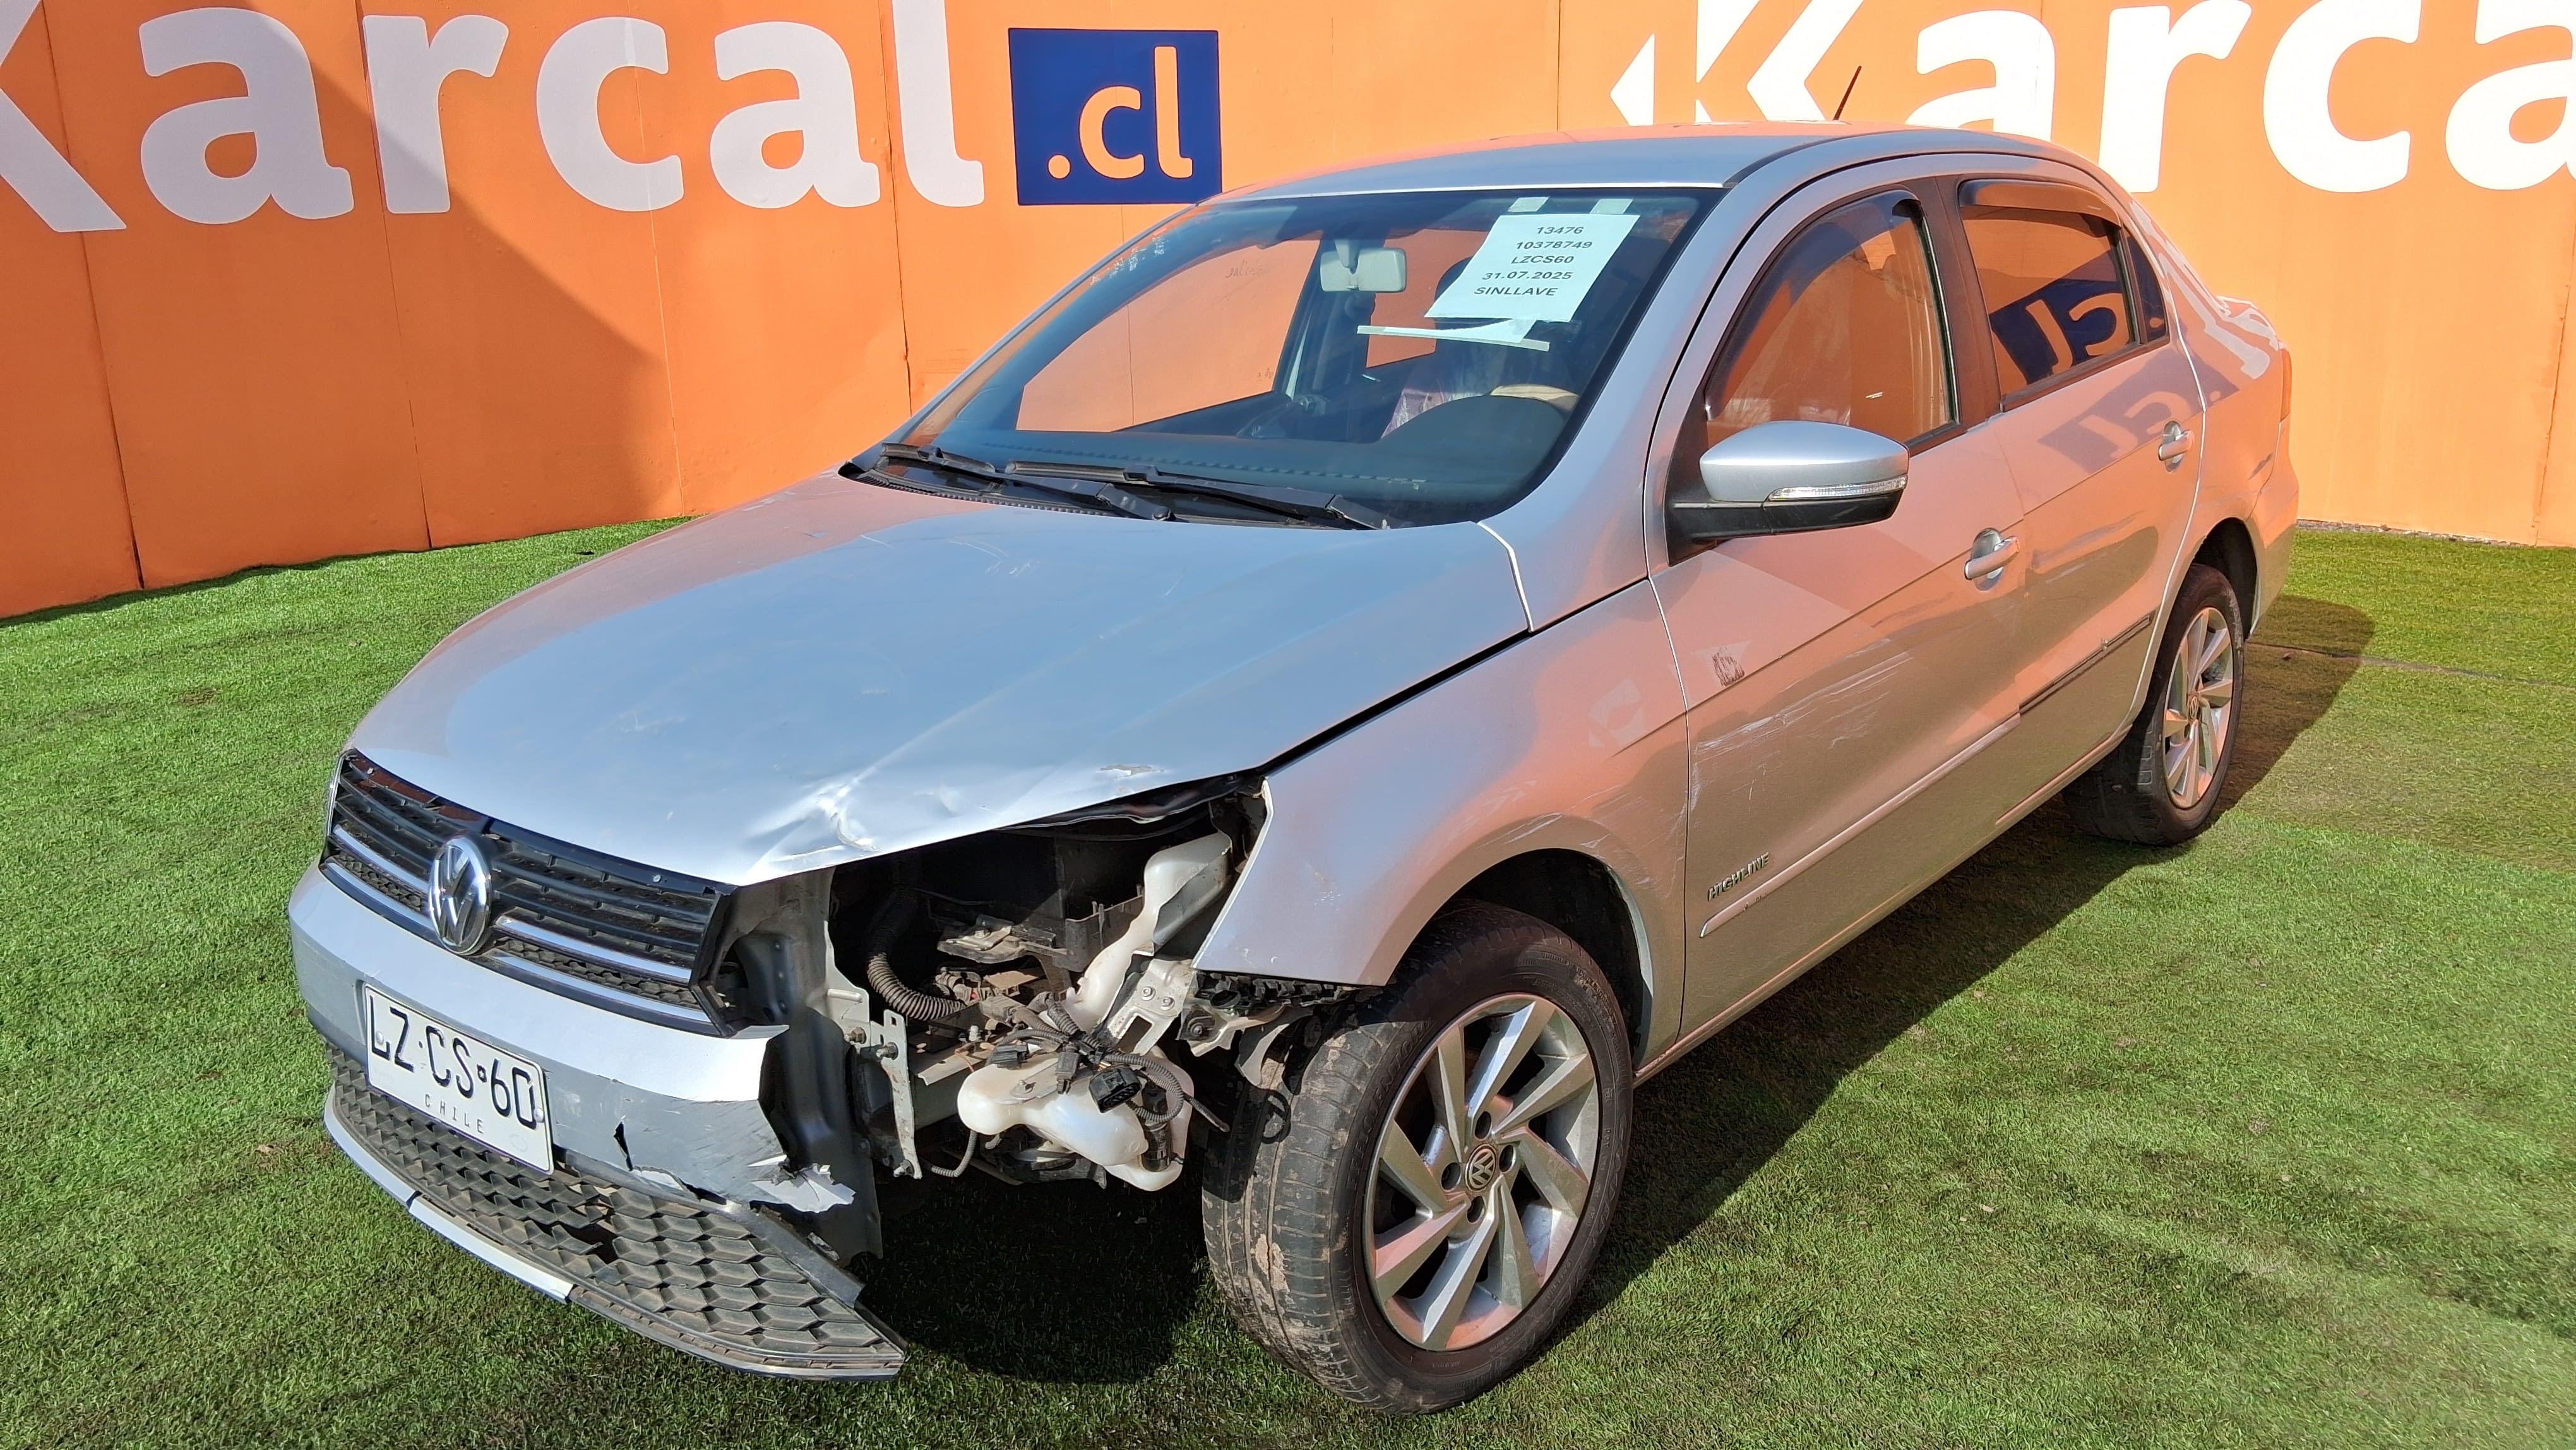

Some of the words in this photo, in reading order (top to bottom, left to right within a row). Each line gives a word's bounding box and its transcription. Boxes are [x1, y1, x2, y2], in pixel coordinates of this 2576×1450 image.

[1047, 45, 1193, 179] .cl
[1536, 225, 1584, 235] 13476
[1516, 240, 1593, 250] 10378749
[1511, 255, 1574, 265] LZCS60
[1482, 270, 1573, 281] 31.07.2025
[1474, 286, 1558, 296] SINLLAVE
[1707, 851, 1769, 902] HIGHLINE
[1345, 1018, 1435, 1190] EFFICIENTGRI
[424, 1093, 486, 1134] CHILE
